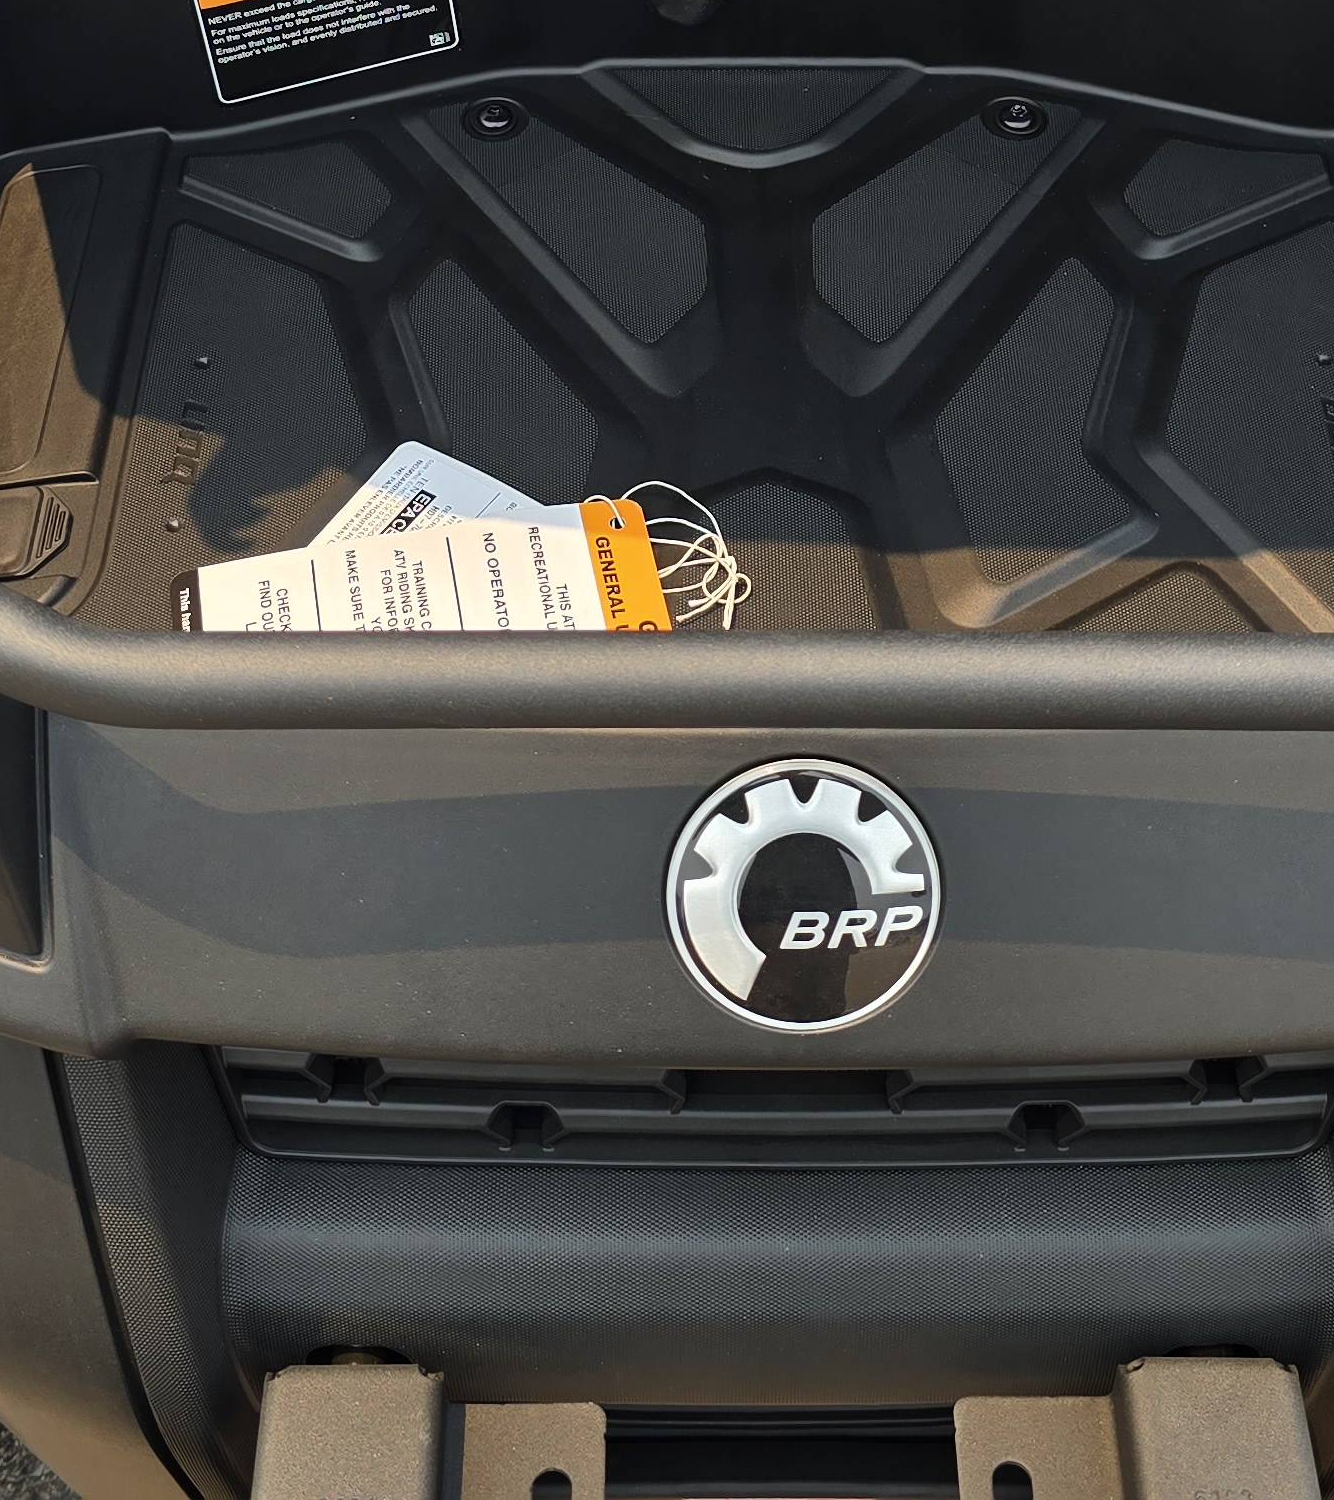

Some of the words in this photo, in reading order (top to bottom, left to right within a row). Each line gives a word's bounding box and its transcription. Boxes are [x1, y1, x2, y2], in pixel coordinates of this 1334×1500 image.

[207, 10, 242, 26] NEVER
[243, 3, 275, 17] exceed
[276, 0, 291, 9] the
[210, 27, 226, 37] For
[227, 16, 270, 33] maximum
[270, 10, 295, 23] loads
[212, 36, 225, 45] on
[225, 33, 240, 42] the
[241, 25, 272, 38] vehicle
[273, 22, 283, 30] or
[284, 20, 294, 28] to
[295, 16, 309, 25] the
[310, 5, 354, 22] operator's
[215, 42, 247, 56] Ensure
[247, 37, 265, 48] that
[265, 34, 280, 44] the
[281, 29, 301, 40] load
[301, 23, 323, 35] does
[324, 19, 340, 29] not
[340, 10, 376, 25] interfere
[376, 6, 395, 17] with
[395, 2, 410, 12] the
[217, 47, 261, 65] operator's
[290, 35, 308, 46] and
[308, 28, 338, 43] evenly
[338, 17, 382, 34] distributed
[383, 13, 400, 23] and
[400, 491, 431, 522] EPA
[394, 549, 407, 569] ATV
[482, 532, 497, 553] NO
[345, 549, 360, 584] MAKE
[380, 569, 393, 594] FOR
[527, 526, 556, 619] RECREATIONAL
[595, 536, 626, 619] GENERAL
[179, 587, 191, 612] This
[258, 580, 272, 609] FIND
[350, 586, 365, 622] SURE
[397, 572, 413, 614] RIDING
[412, 560, 430, 618] TRAINING
[487, 557, 510, 630] OPERATO
[556, 583, 572, 611] THIS
[261, 612, 275, 631] OU
[276, 588, 293, 631] CHECK
[561, 615, 575, 630] AT
[779, 905, 923, 950] BRP
